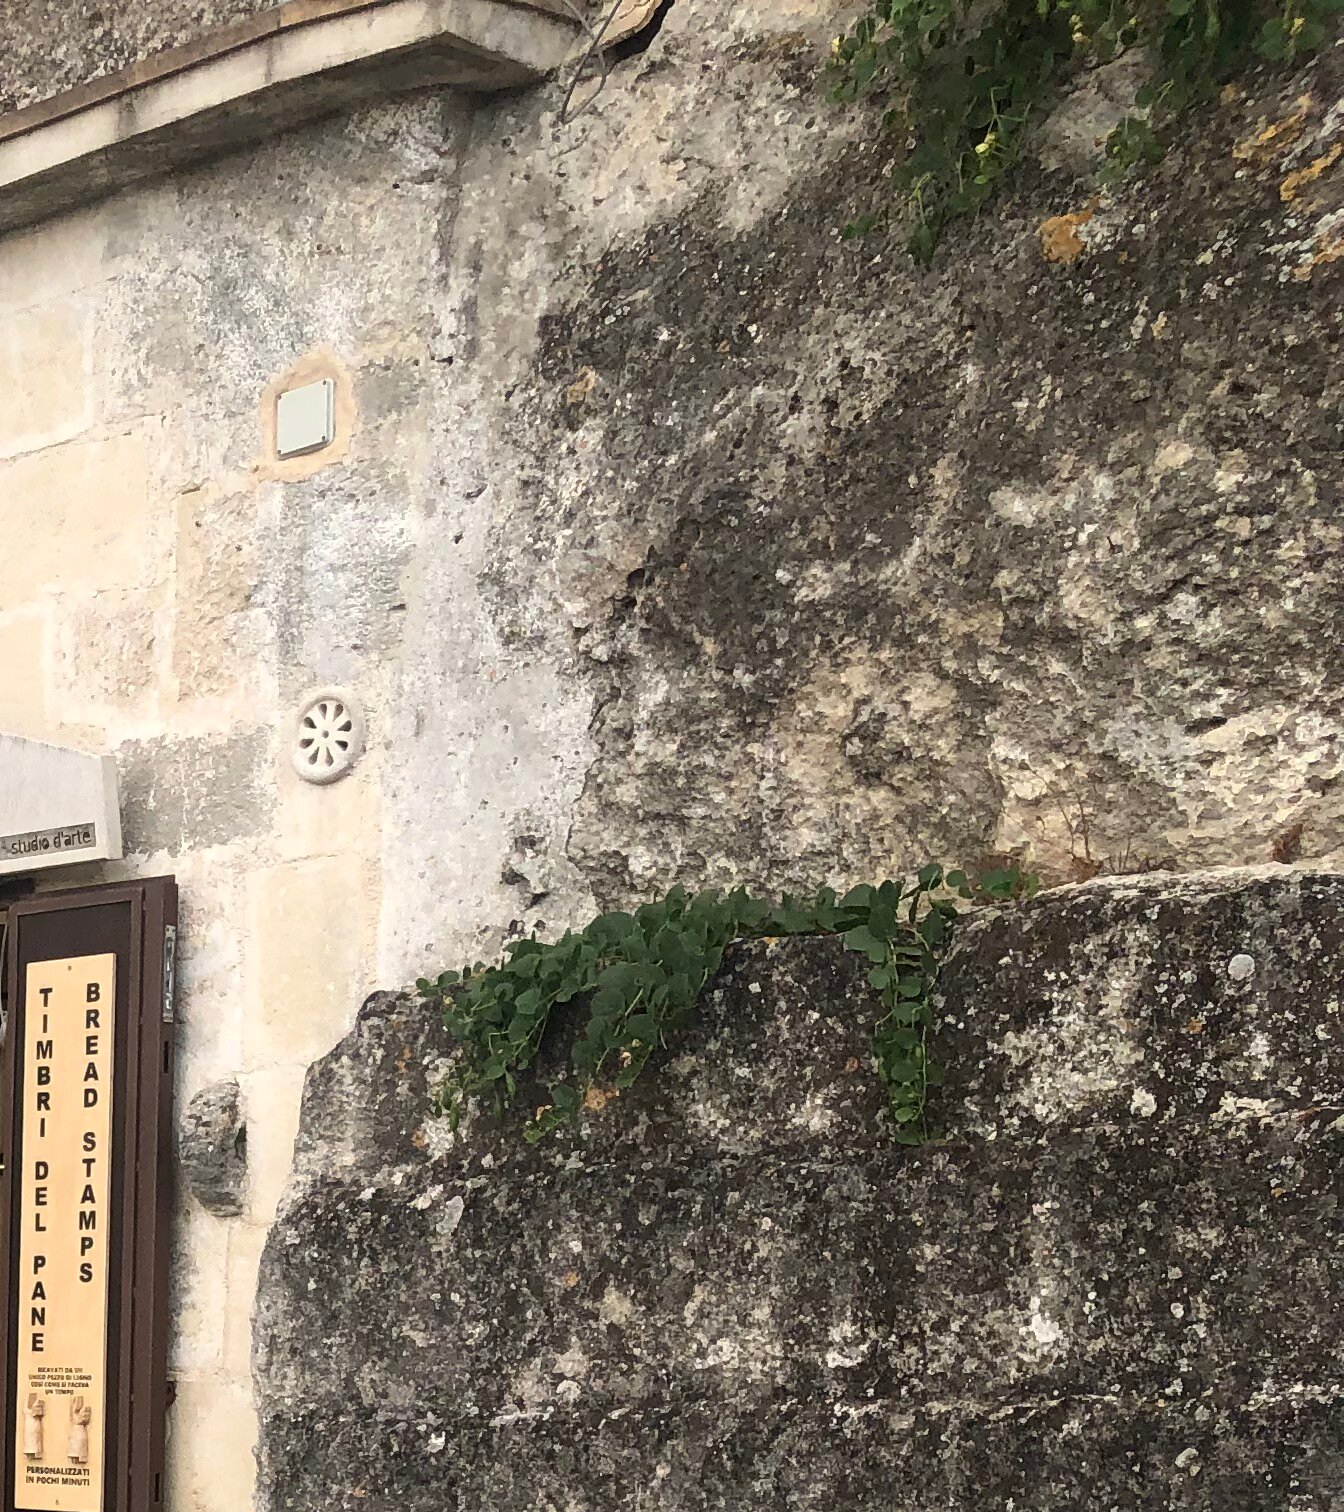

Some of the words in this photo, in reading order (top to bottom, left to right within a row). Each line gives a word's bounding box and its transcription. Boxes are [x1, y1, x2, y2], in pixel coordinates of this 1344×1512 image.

[10, 837, 50, 855] studio
[53, 829, 92, 849] d'arte
[36, 987, 53, 1138] TIMBRI
[83, 982, 100, 1109] BREAD
[35, 1161, 49, 1232] DEL
[79, 1131, 97, 1283] STAMPS
[31, 1255, 46, 1352] PANE
[26, 1466, 90, 1476] PERSONALIZZATI
[36, 1476, 59, 1484] POCHI
[61, 1477, 90, 1486] MINUTI
